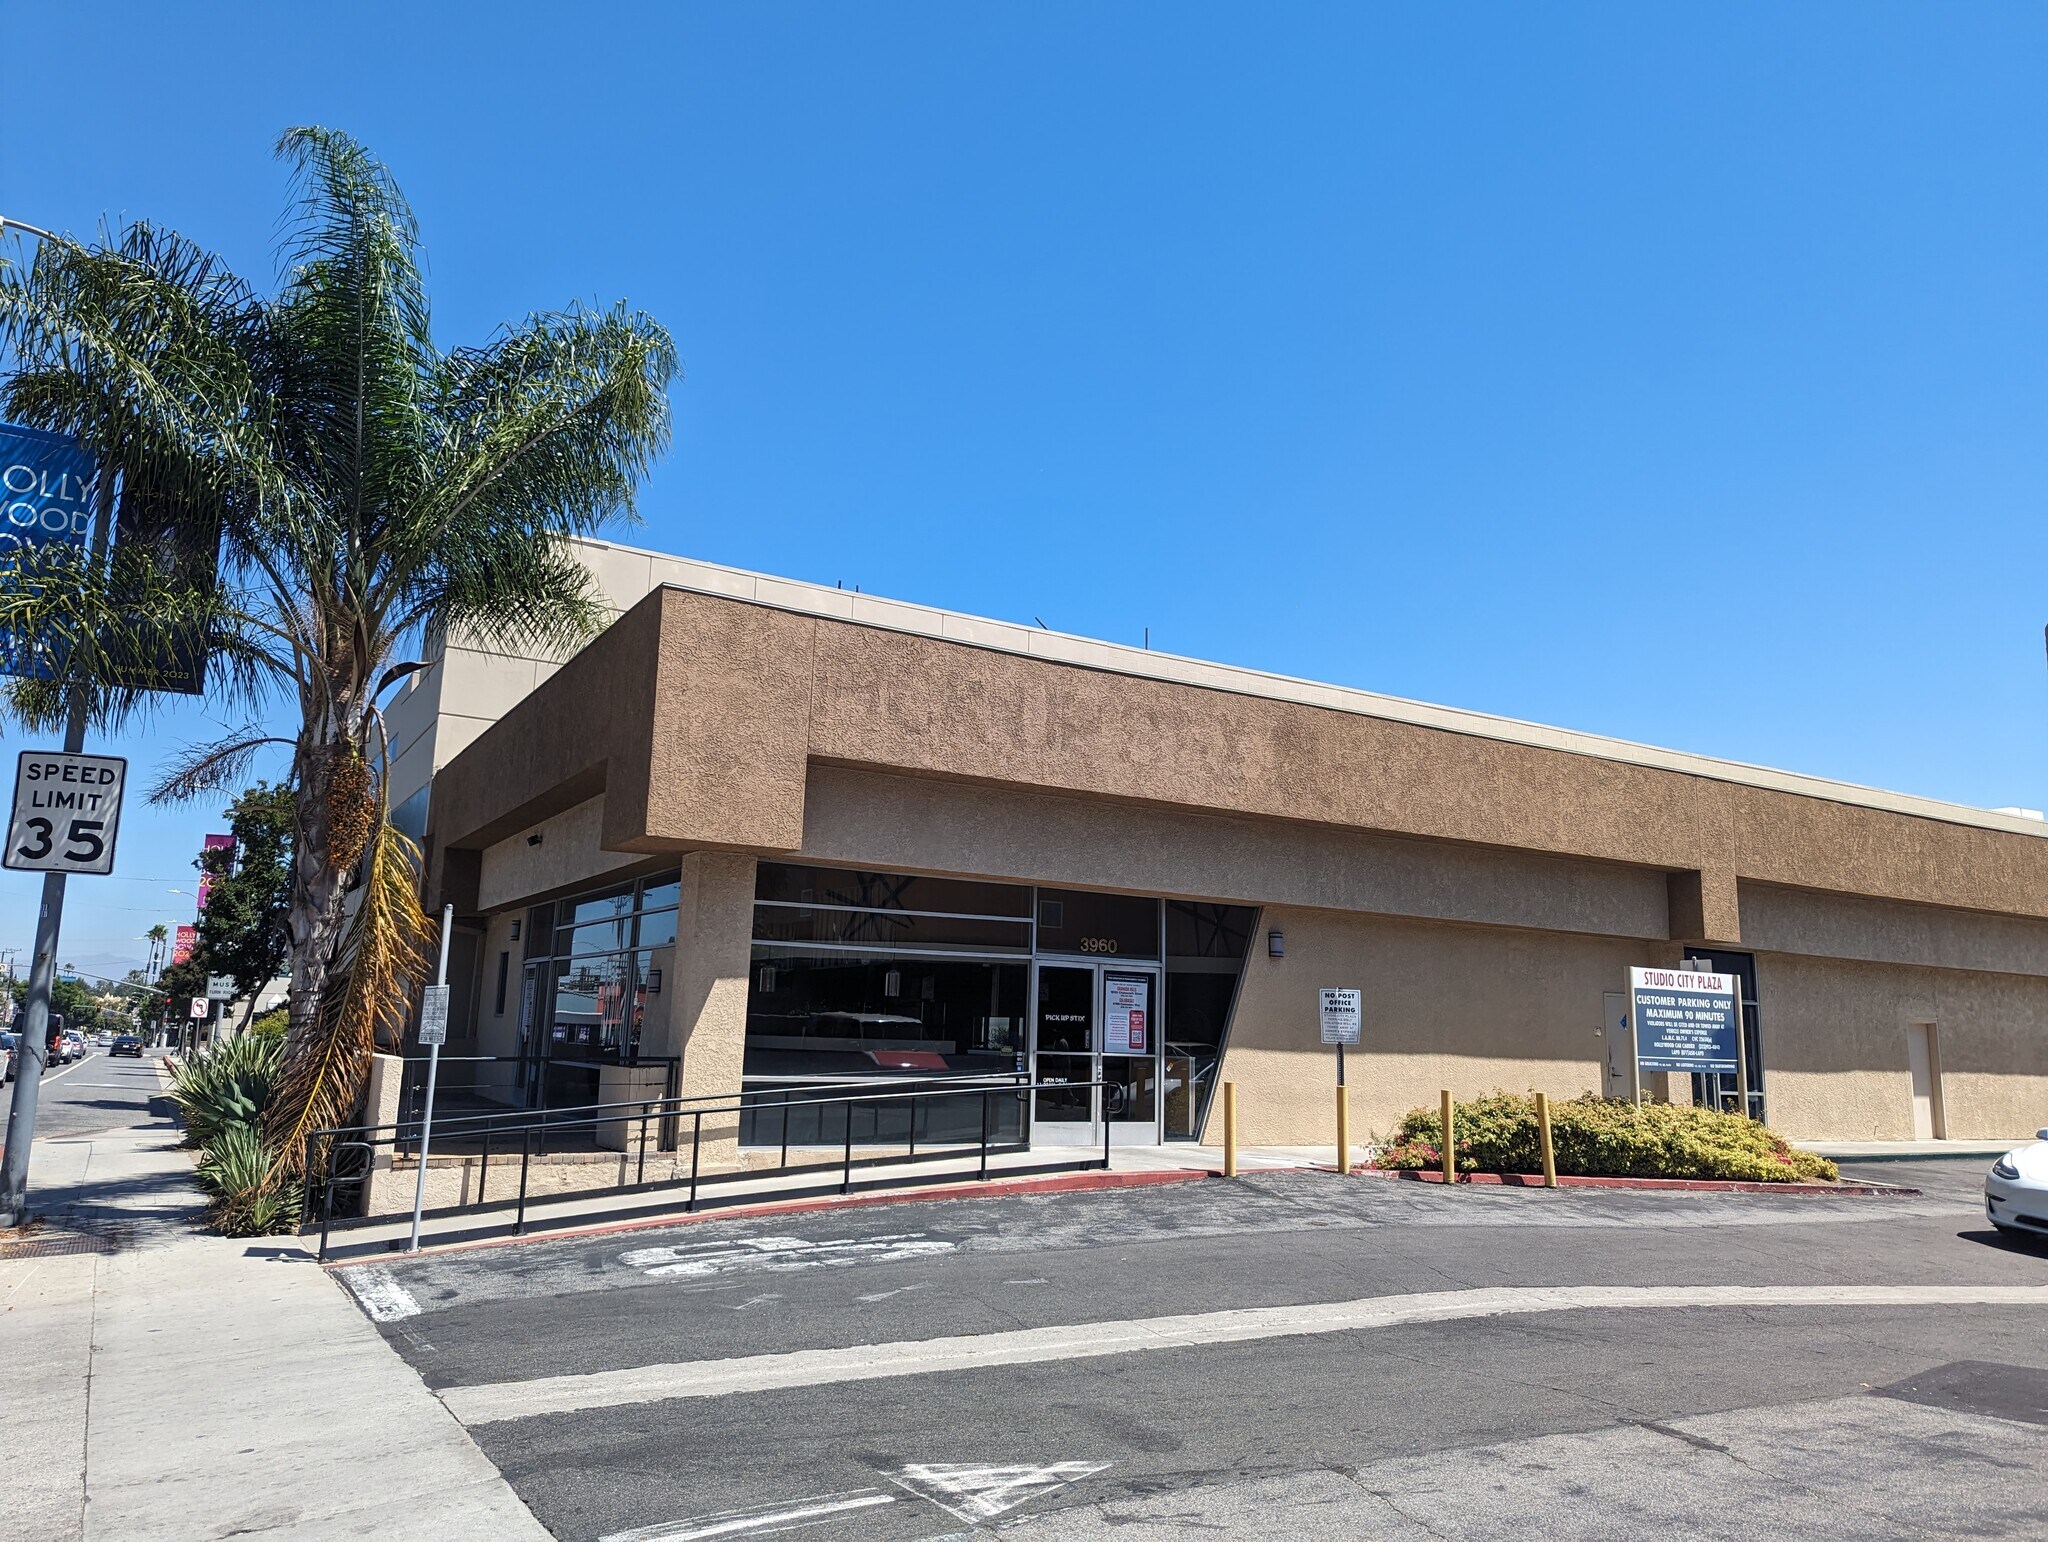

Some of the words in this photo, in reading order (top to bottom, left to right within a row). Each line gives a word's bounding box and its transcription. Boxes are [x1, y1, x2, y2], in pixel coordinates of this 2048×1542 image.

[163, 670, 190, 680] 2023
[26, 763, 116, 786] SPEED
[32, 790, 103, 811] LIMIT
[17, 816, 104, 863] 35
[1080, 937, 1118, 954] 3960
[1644, 972, 1674, 987] STUDIO
[1677, 974, 1694, 988] CITY
[1698, 976, 1722, 990] PLAZA
[1636, 994, 1676, 1006] CUSTOMER
[1678, 998, 1711, 1009] PARKING
[1713, 1000, 1731, 1010] ONLY
[1646, 1008, 1683, 1019] MAXIMUM
[1685, 1011, 1693, 1020] 90
[1696, 1011, 1725, 1022] MINUTES
